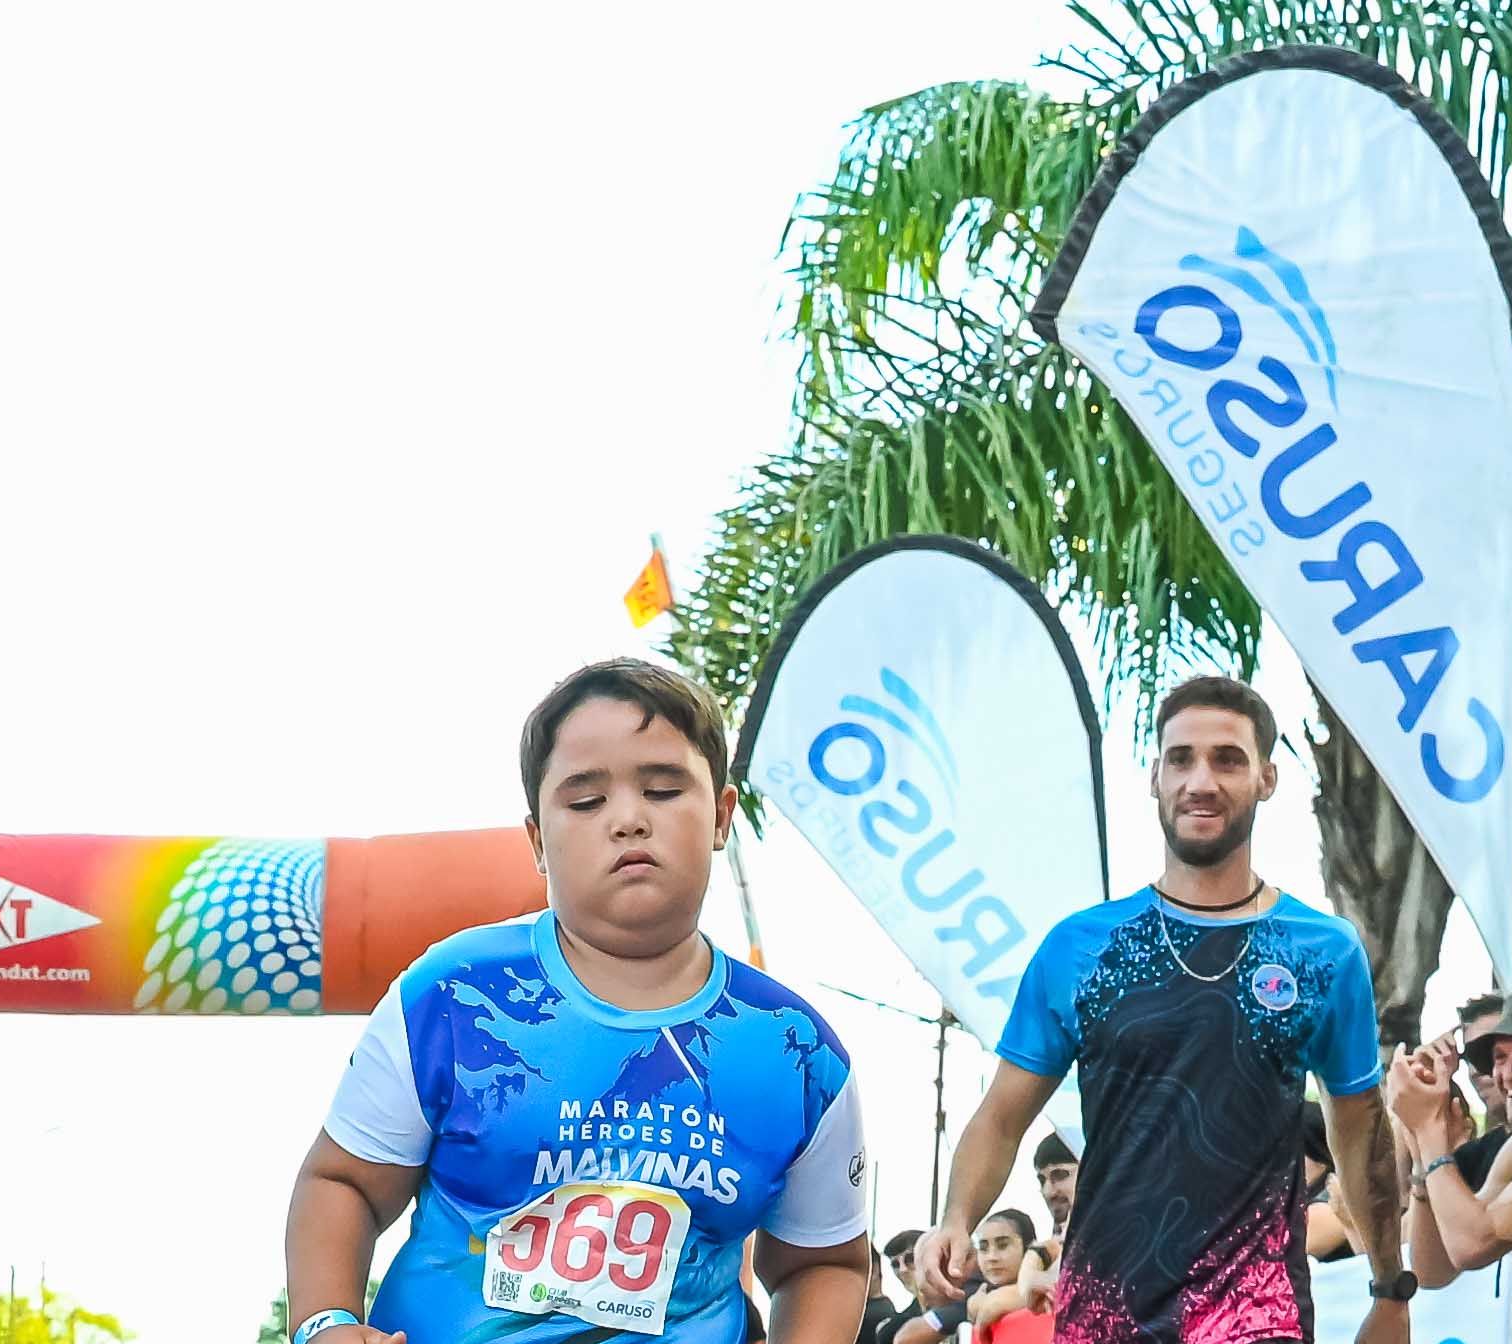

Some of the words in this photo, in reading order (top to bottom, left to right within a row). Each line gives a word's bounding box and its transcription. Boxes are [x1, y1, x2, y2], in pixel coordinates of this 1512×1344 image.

[559, 1100, 726, 1137] MARATÓN
[559, 1121, 673, 1145] HÉROES
[689, 1132, 725, 1157] DE
[532, 1148, 742, 1205] MALVINAS
[597, 1300, 653, 1319] CARUSO
